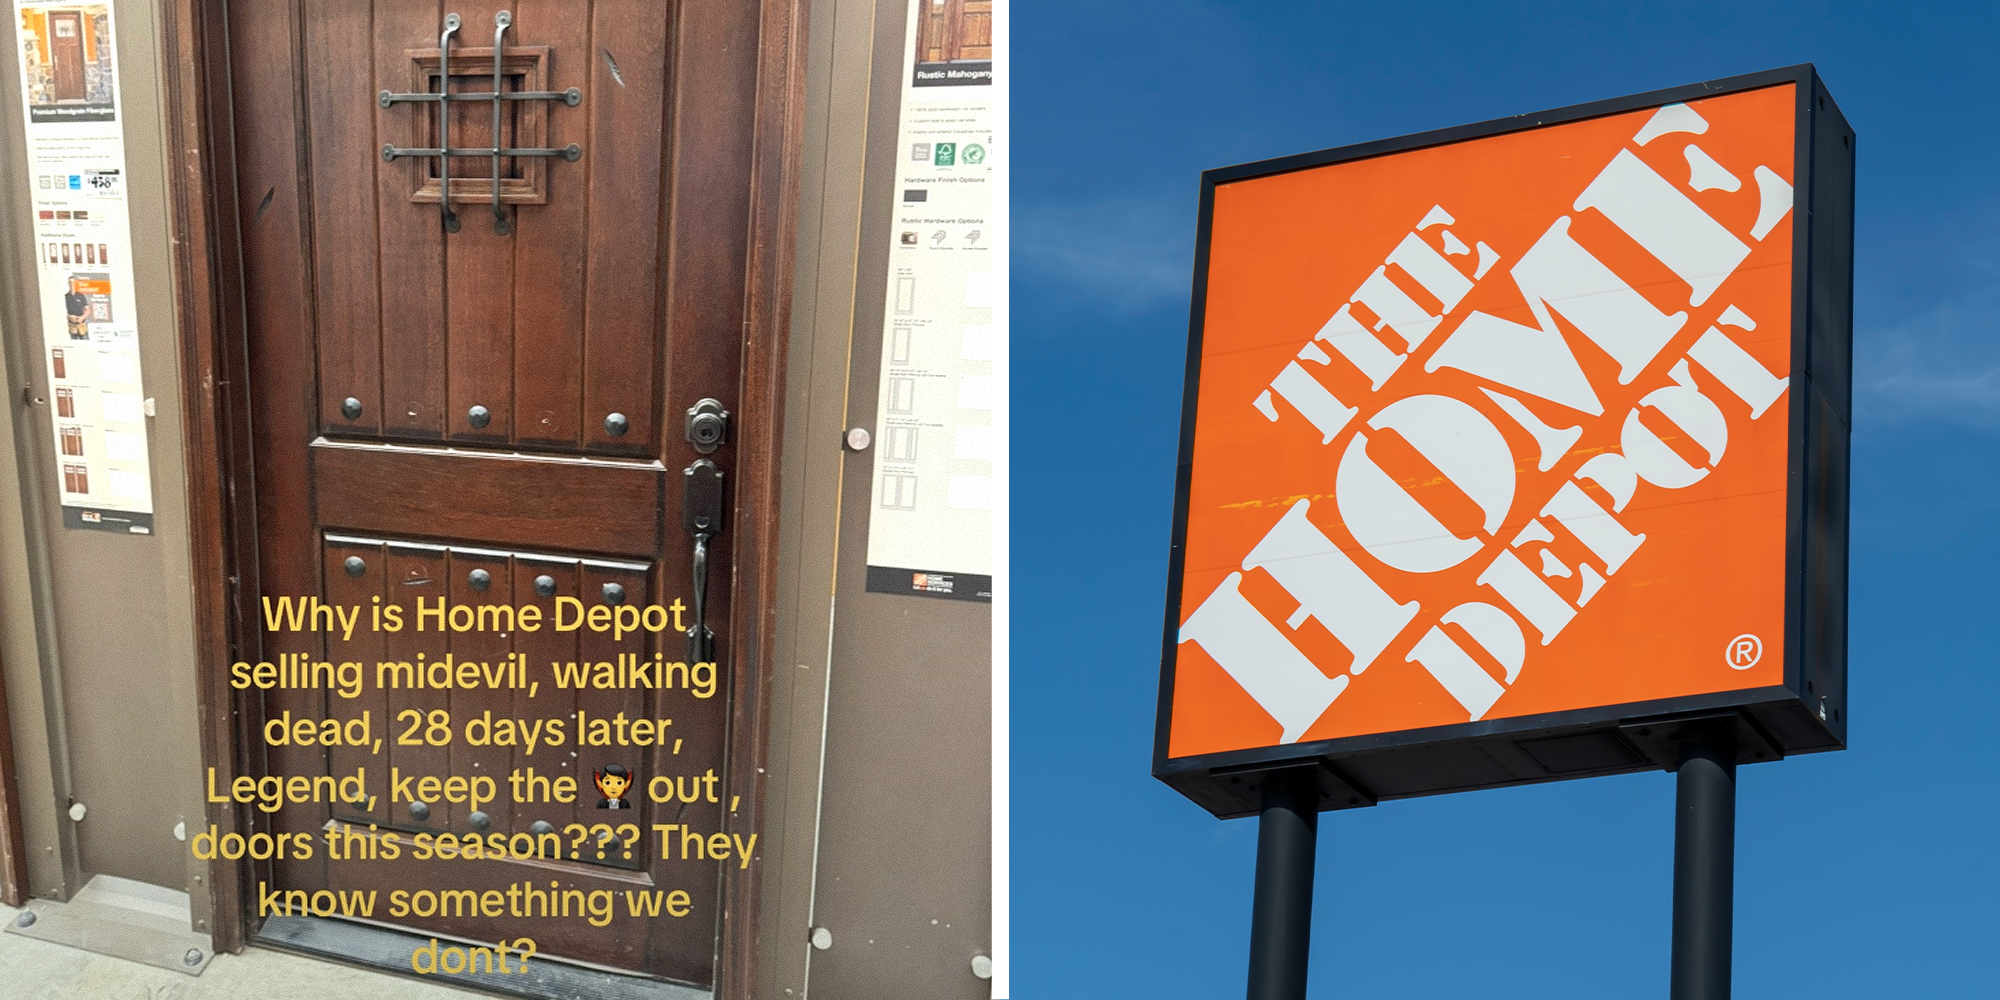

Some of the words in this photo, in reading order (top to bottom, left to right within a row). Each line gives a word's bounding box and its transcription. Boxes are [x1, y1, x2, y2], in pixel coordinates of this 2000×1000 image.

[917, 71, 946, 80] Rustic
[947, 70, 992, 79] Mahogany
[1178, 102, 1794, 744] HOME
[1252, 204, 1500, 444] THE
[1405, 303, 1790, 721] DEPOT
